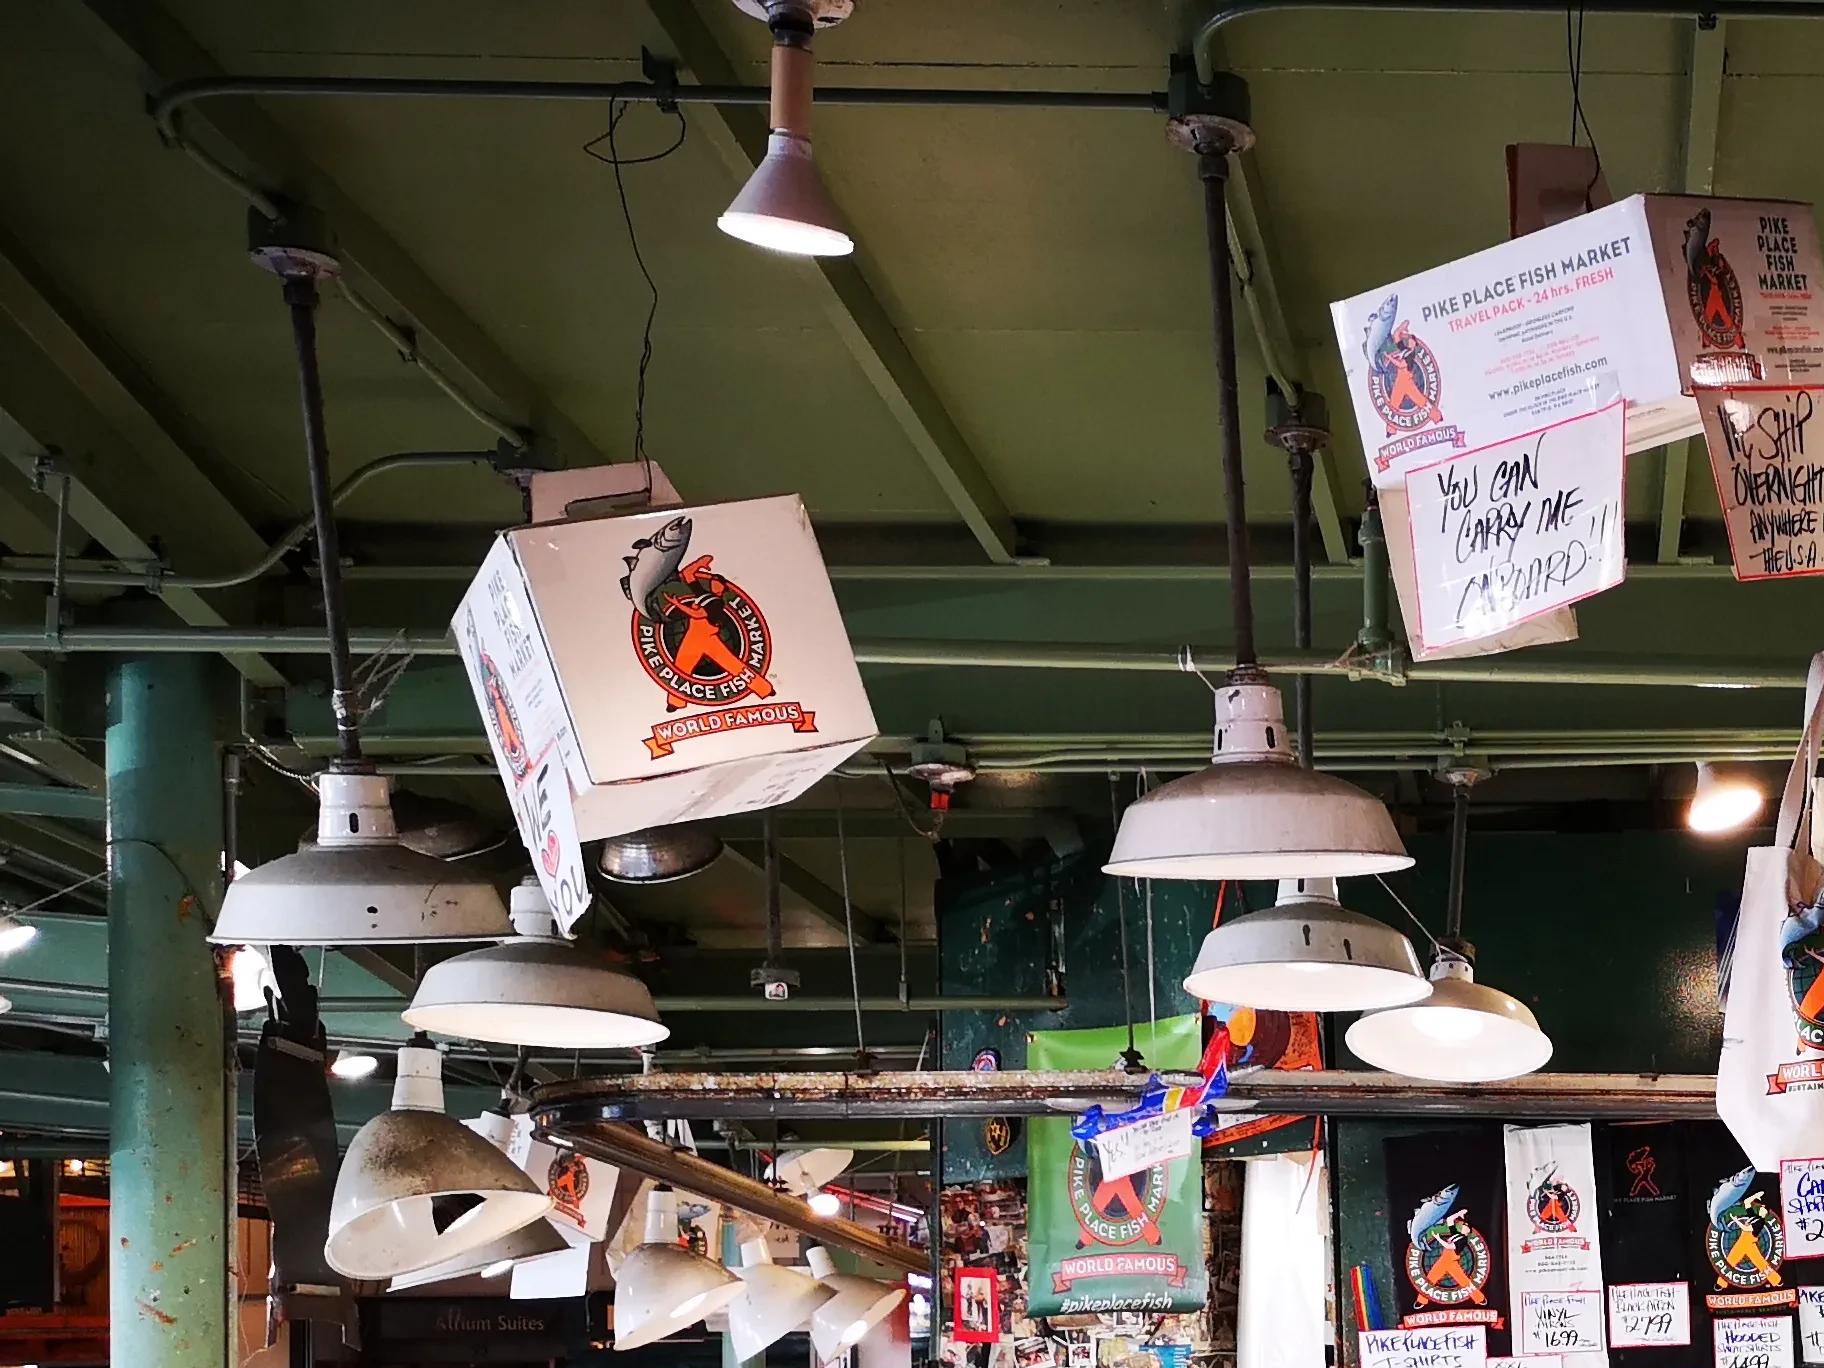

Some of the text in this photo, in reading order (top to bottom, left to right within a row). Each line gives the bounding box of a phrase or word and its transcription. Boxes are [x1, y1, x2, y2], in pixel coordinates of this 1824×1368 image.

[1759, 216, 1790, 234] PIKE
[1757, 235, 1798, 254] PLACE
[1765, 254, 1795, 272] FISH
[1421, 236, 1632, 322] PIKE PLACE FISH MARKET
[1758, 273, 1809, 291] MARKET
[1447, 308, 1491, 334] TRAVEL
[1491, 297, 1526, 319] PACK
[1575, 266, 1615, 289] FRESH
[1756, 391, 1812, 463] SHIP
[1437, 432, 1546, 533] YOU CAN
[1455, 487, 1584, 564] CARRY ME
[1748, 507, 1816, 547] ANYWHERE
[637, 595, 767, 700] PIKE PLACE FISH MARKET
[657, 704, 800, 743] WORLD FAMOUS
[1072, 1156, 1149, 1240] PIKE PLACE FISH
[1710, 1216, 1785, 1285] PIKE PLACE FISH MARKET
[1064, 1255, 1176, 1275] WORLD FAMOUS
[1408, 1236, 1491, 1302] PIKE PLACE FISH MARKET
[1060, 1294, 1173, 1313] #pikeplacefish
[1708, 1290, 1794, 1307] WORLD FAMOUS
[496, 1314, 546, 1332] Suites
[1406, 1311, 1498, 1326] WORLD FAMOUS
[1534, 1307, 1582, 1321] VINYL
[1365, 1334, 1402, 1354] PIKE
[1444, 1331, 1479, 1350] FISH
[1725, 1330, 1782, 1344] HOODED
